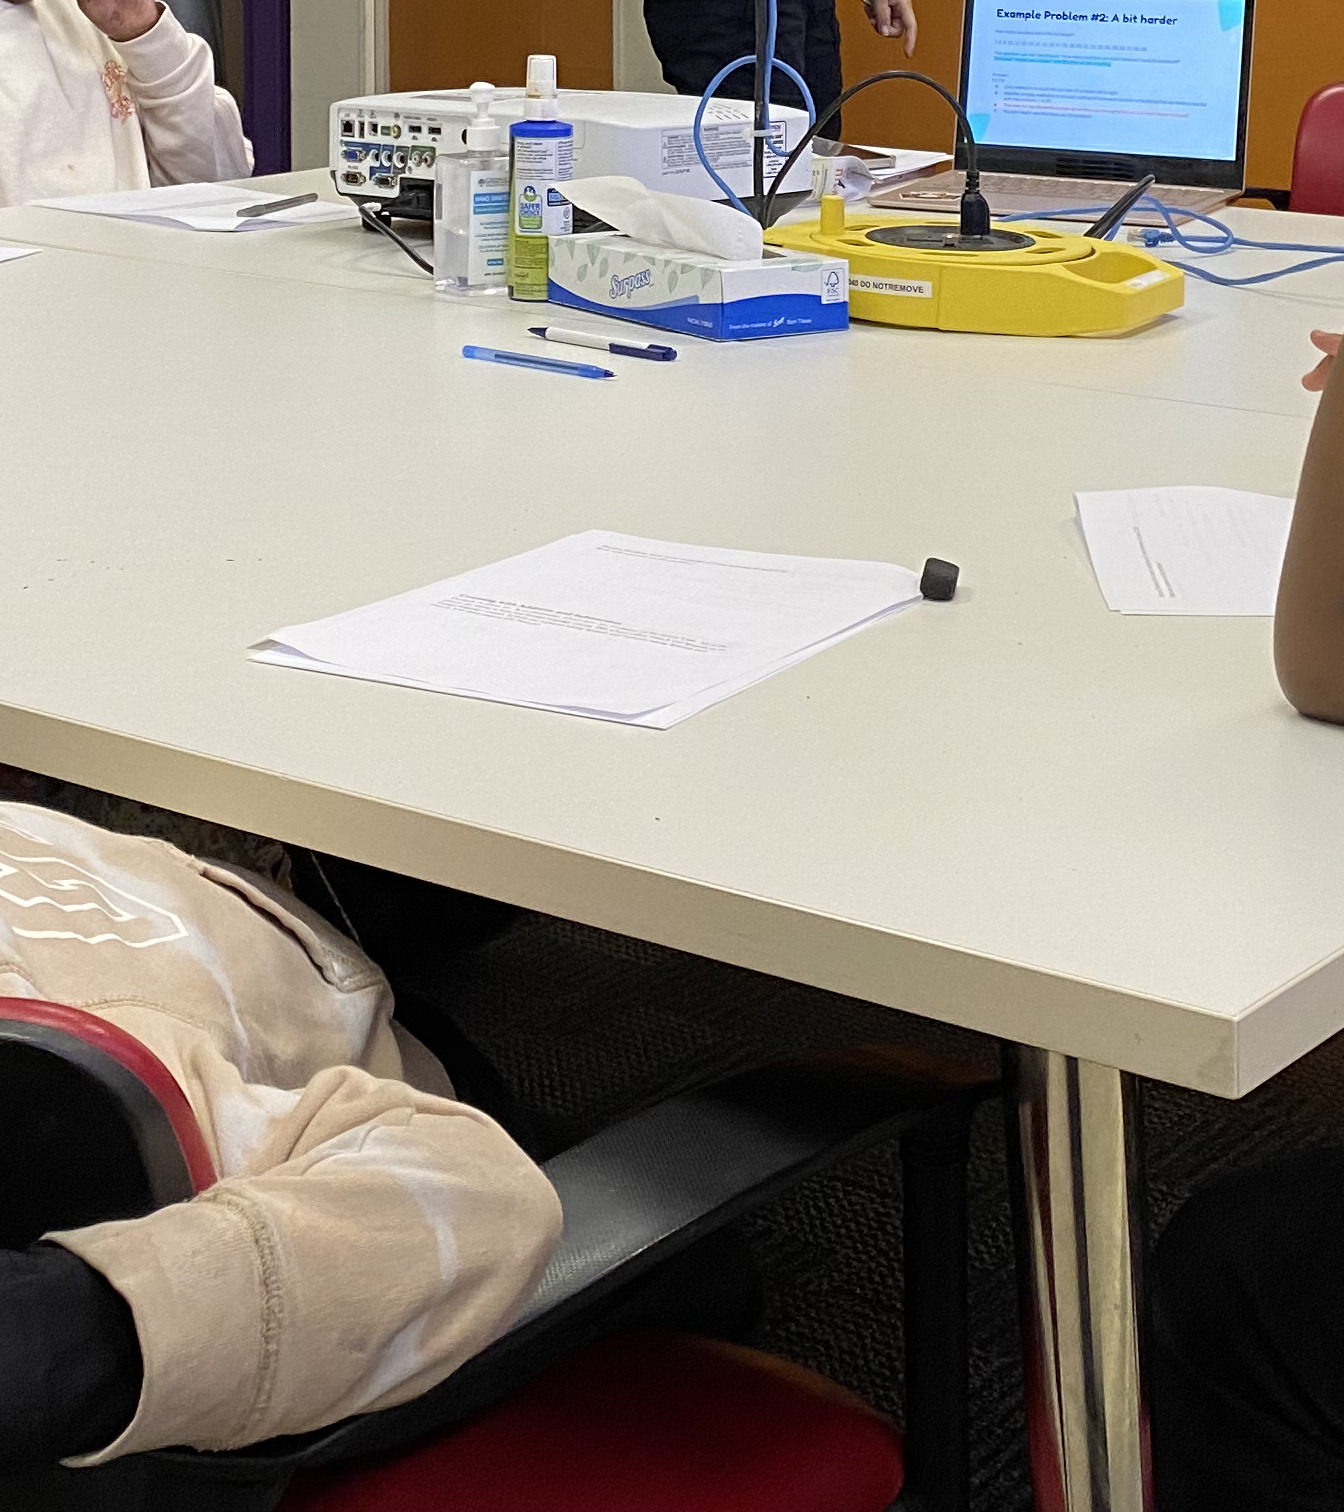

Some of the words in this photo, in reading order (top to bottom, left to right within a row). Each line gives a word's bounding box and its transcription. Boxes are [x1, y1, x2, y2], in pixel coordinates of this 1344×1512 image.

[996, 8, 1042, 21] Example
[1044, 9, 1088, 22] Problem
[1091, 12, 1109, 23] #2:
[1111, 13, 1120, 23] A
[1122, 13, 1138, 24] bit
[1140, 15, 1178, 26] harder
[609, 268, 651, 300] Surpass
[860, 280, 871, 288] DO
